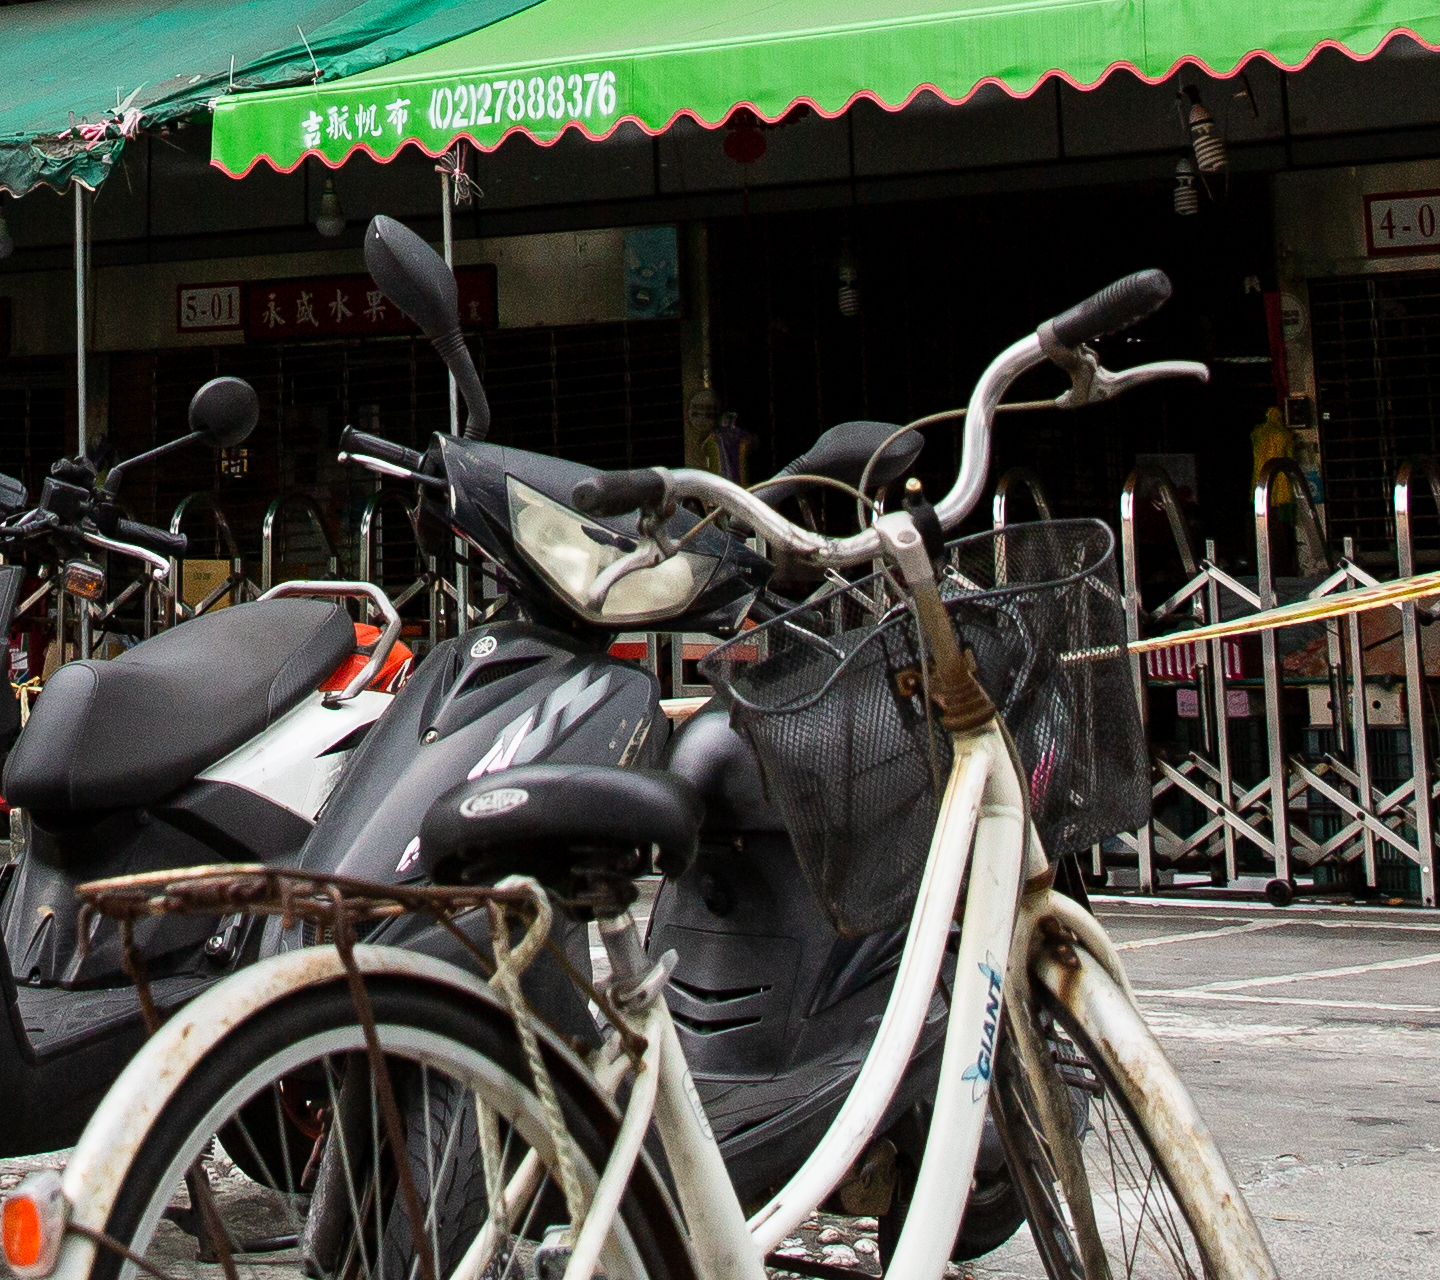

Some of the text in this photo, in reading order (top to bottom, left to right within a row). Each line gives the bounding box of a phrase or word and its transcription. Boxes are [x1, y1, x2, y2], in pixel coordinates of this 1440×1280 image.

[301, 69, 617, 149] 吉航帆布 (02)27888376
[185, 292, 236, 322] 5-01
[977, 969, 1001, 1081] GIANT
